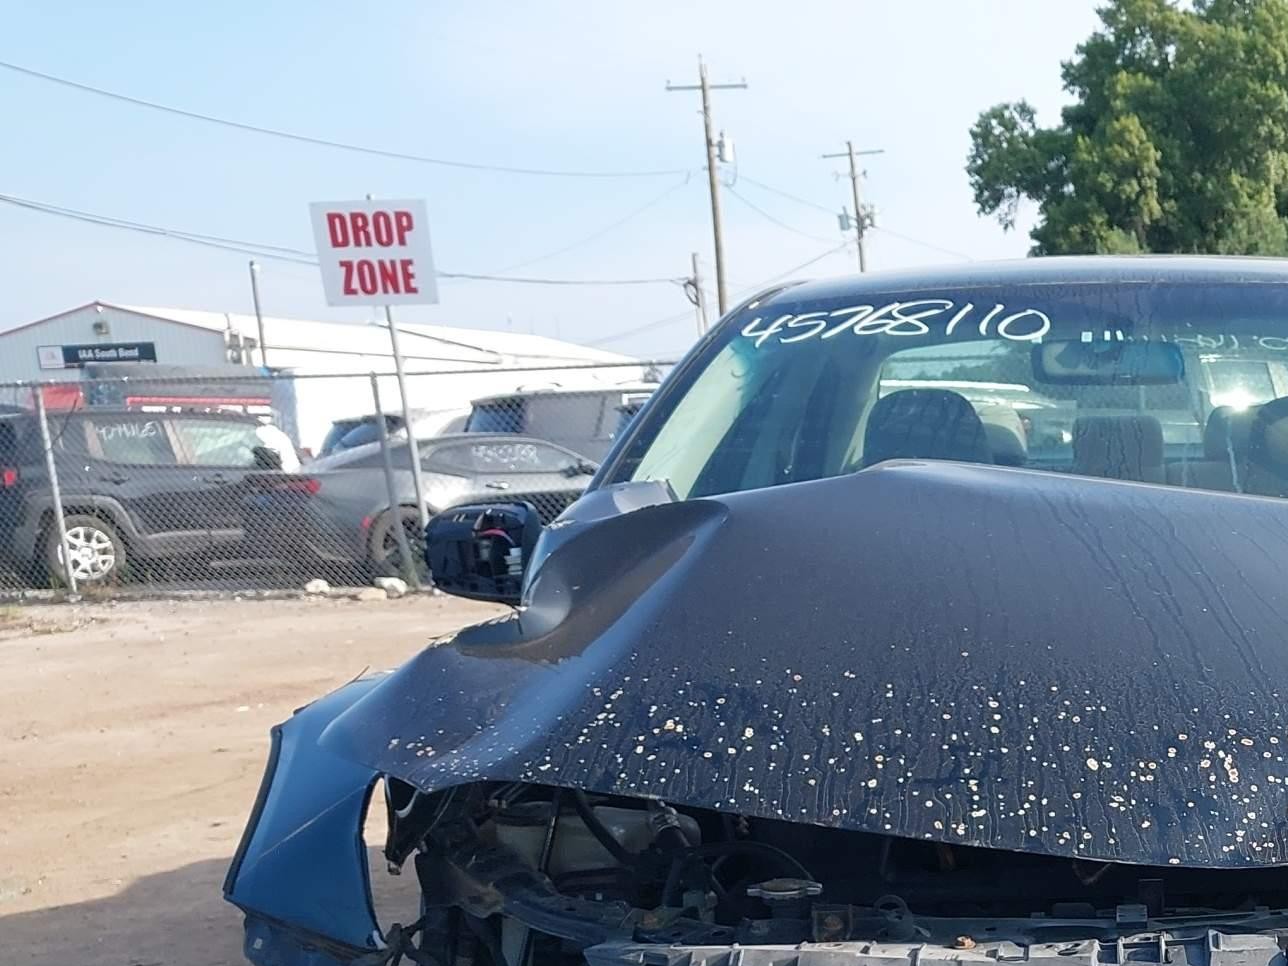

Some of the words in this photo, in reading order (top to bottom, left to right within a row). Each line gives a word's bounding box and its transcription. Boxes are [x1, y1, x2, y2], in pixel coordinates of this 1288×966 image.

[326, 210, 414, 248] DROP
[339, 258, 419, 296] ZONE
[740, 299, 1051, 348] 45768110
[95, 348, 118, 360] South
